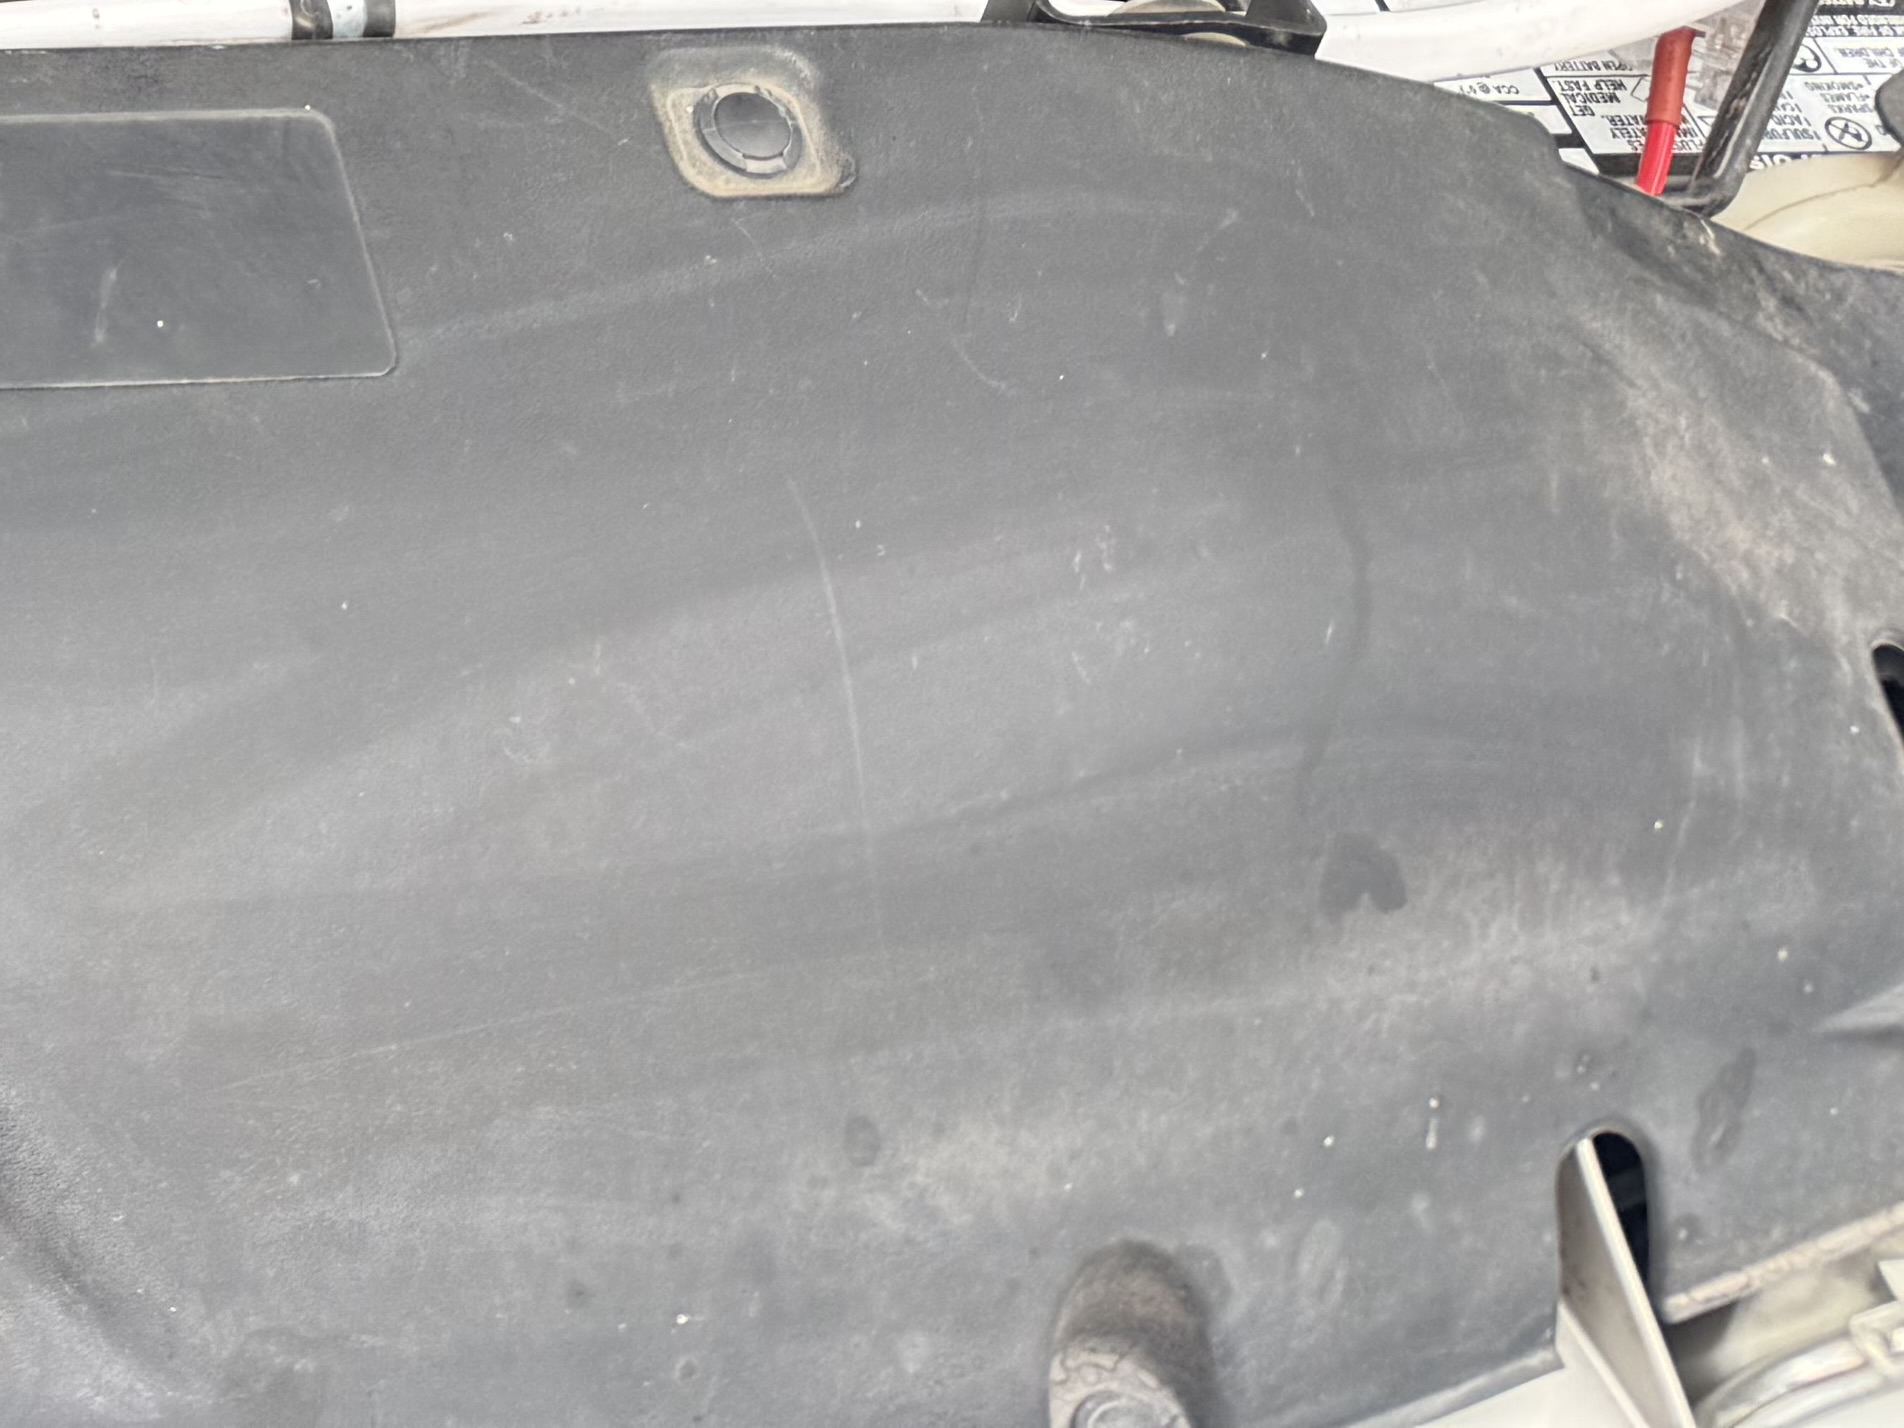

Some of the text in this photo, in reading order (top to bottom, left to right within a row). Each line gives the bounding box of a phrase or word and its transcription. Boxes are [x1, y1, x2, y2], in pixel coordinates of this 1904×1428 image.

[1553, 60, 1601, 73] BATTERY
[1594, 79, 1629, 92] HELP
[1560, 92, 1621, 104] MEDICAL
[1569, 104, 1596, 117] GET
